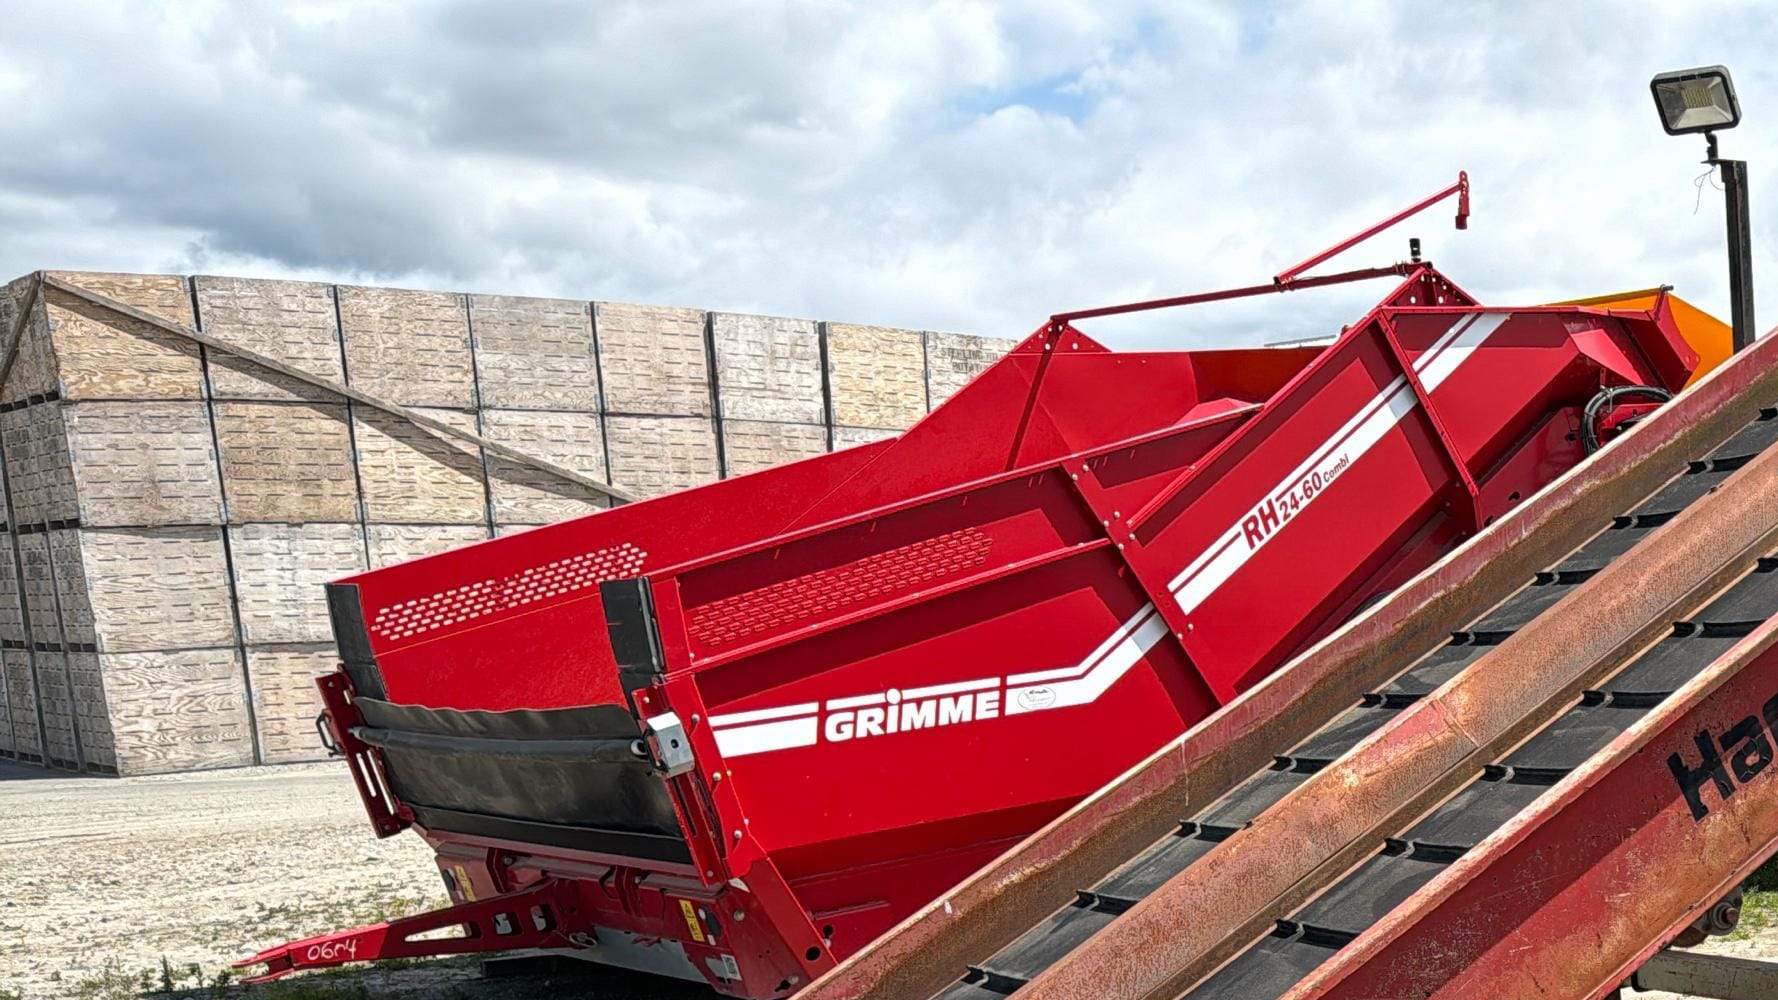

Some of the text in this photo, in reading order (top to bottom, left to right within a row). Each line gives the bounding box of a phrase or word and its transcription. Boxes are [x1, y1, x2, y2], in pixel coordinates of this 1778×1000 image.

[1241, 453, 1350, 550] RH 24-60 Combi
[824, 688, 1000, 742] GRIMME
